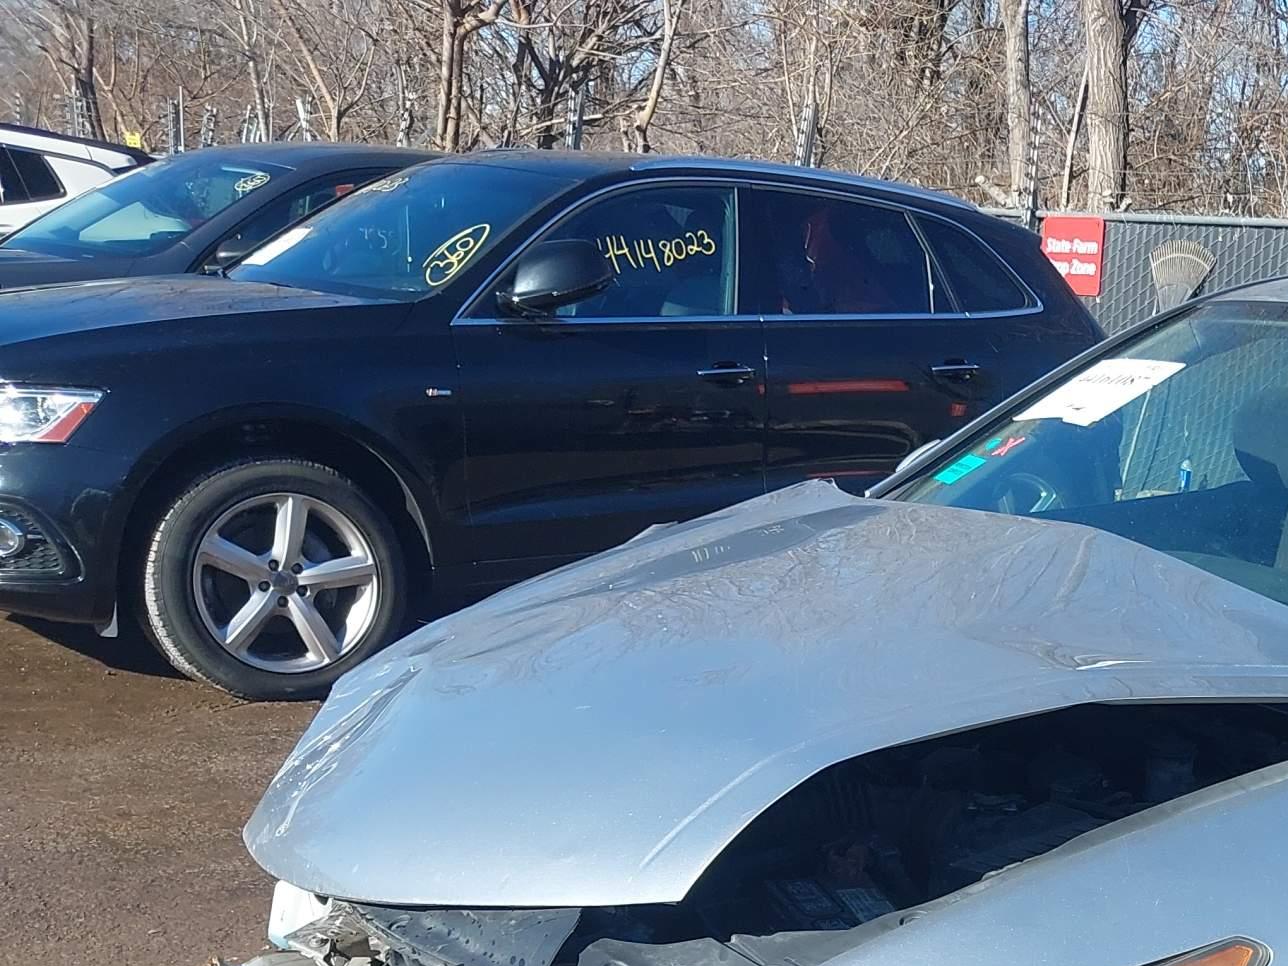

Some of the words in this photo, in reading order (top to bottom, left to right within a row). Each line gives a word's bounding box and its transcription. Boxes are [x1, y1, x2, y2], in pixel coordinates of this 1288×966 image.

[1046, 237, 1072, 253] State
[1072, 238, 1098, 254] Farm
[430, 236, 475, 274] 360
[1070, 258, 1097, 275] Zone
